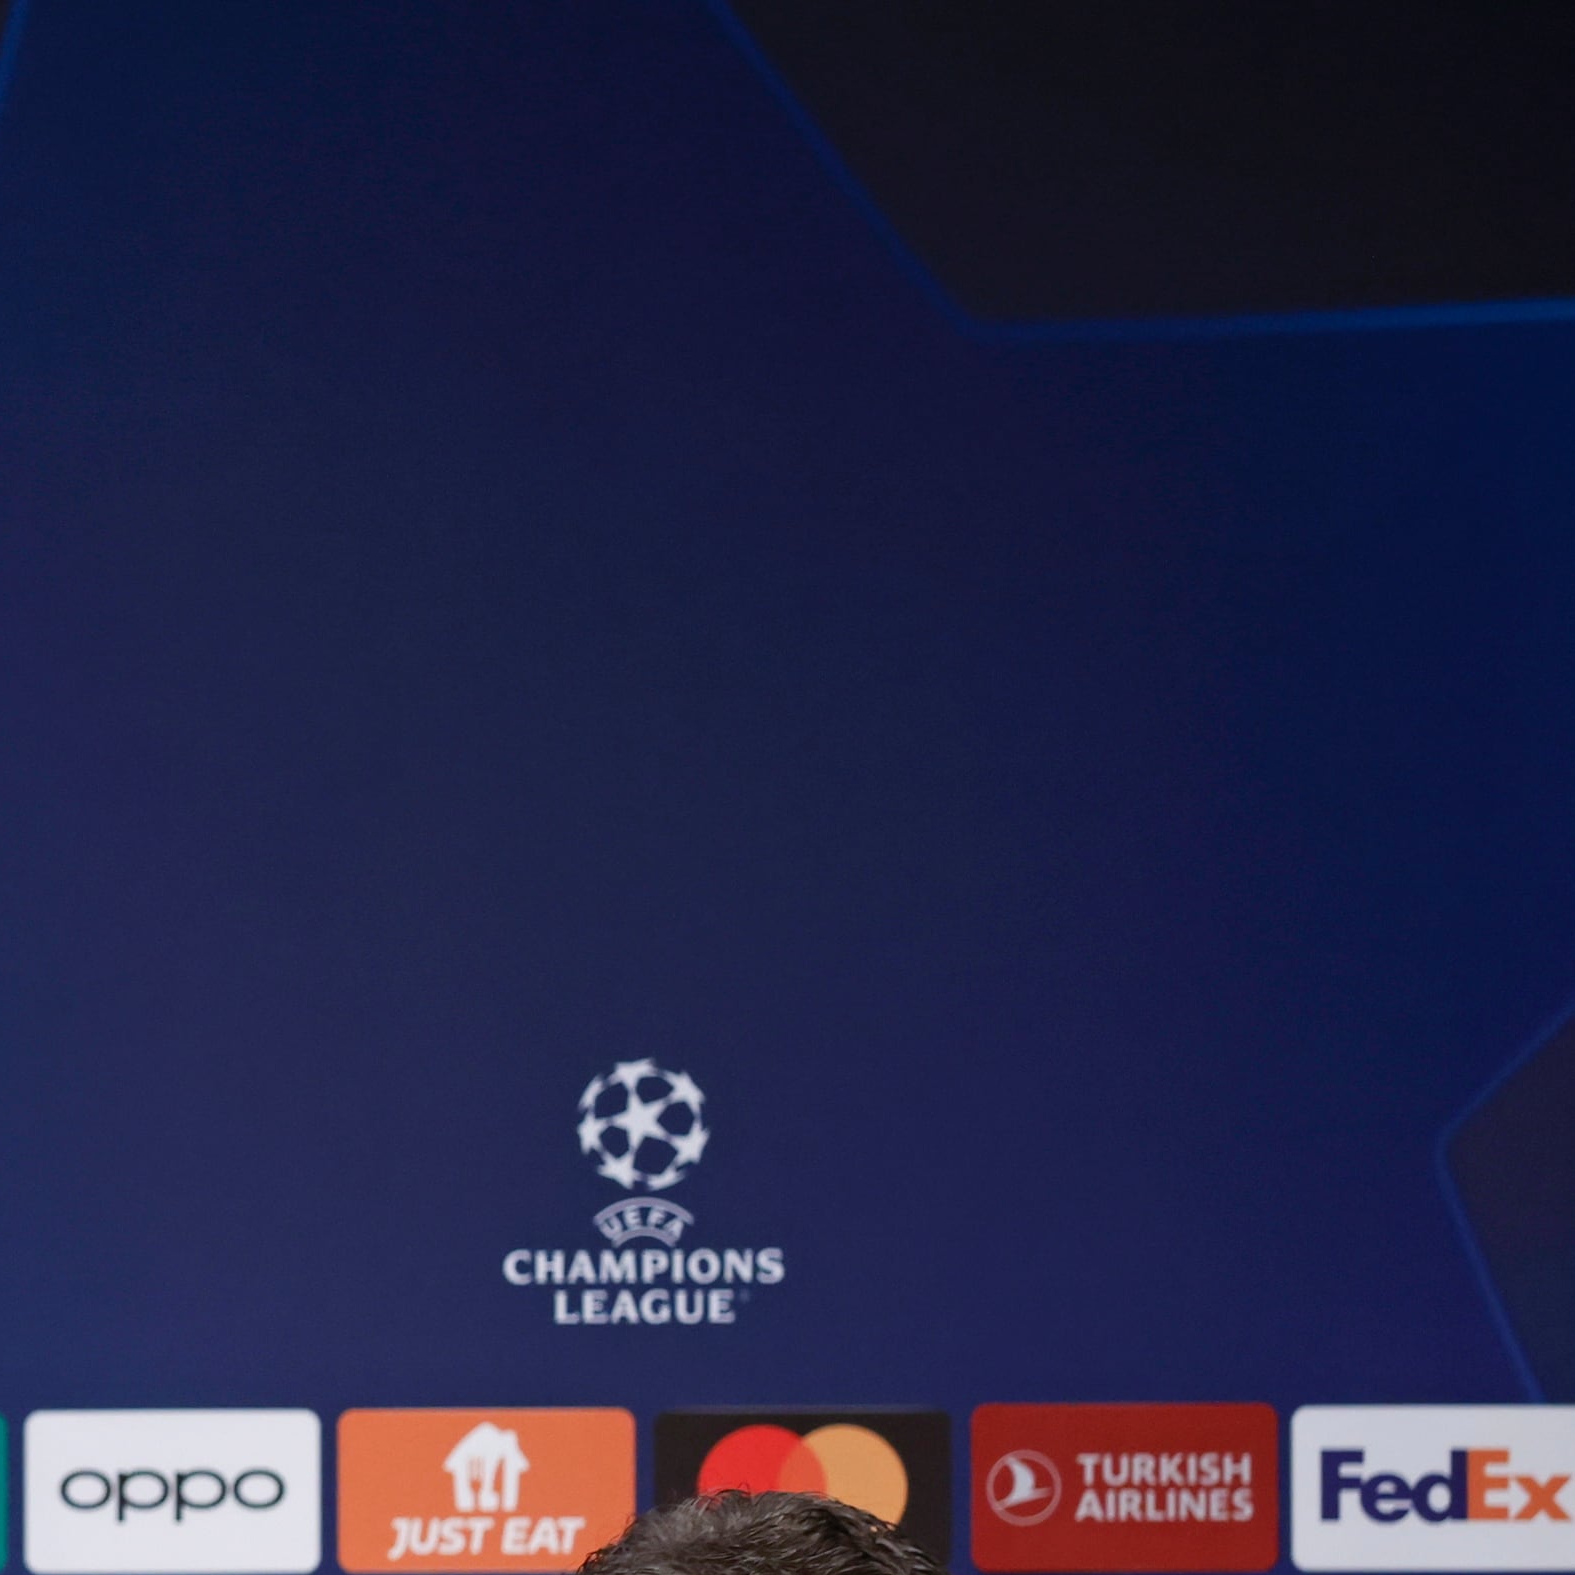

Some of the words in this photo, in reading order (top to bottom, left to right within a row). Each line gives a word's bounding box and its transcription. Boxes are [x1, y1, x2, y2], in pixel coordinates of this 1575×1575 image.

[598, 1206, 684, 1239] UEFA
[503, 1245, 784, 1285] CHAMPIONS
[555, 1289, 734, 1324] LEAGUE
[1077, 1453, 1251, 1489] TURKISH
[1320, 1449, 1571, 1523] FedEx
[60, 1469, 285, 1522] oppo
[1075, 1488, 1253, 1521] AIRLINES
[388, 1517, 494, 1560] JUST
[501, 1517, 589, 1555] EAT
